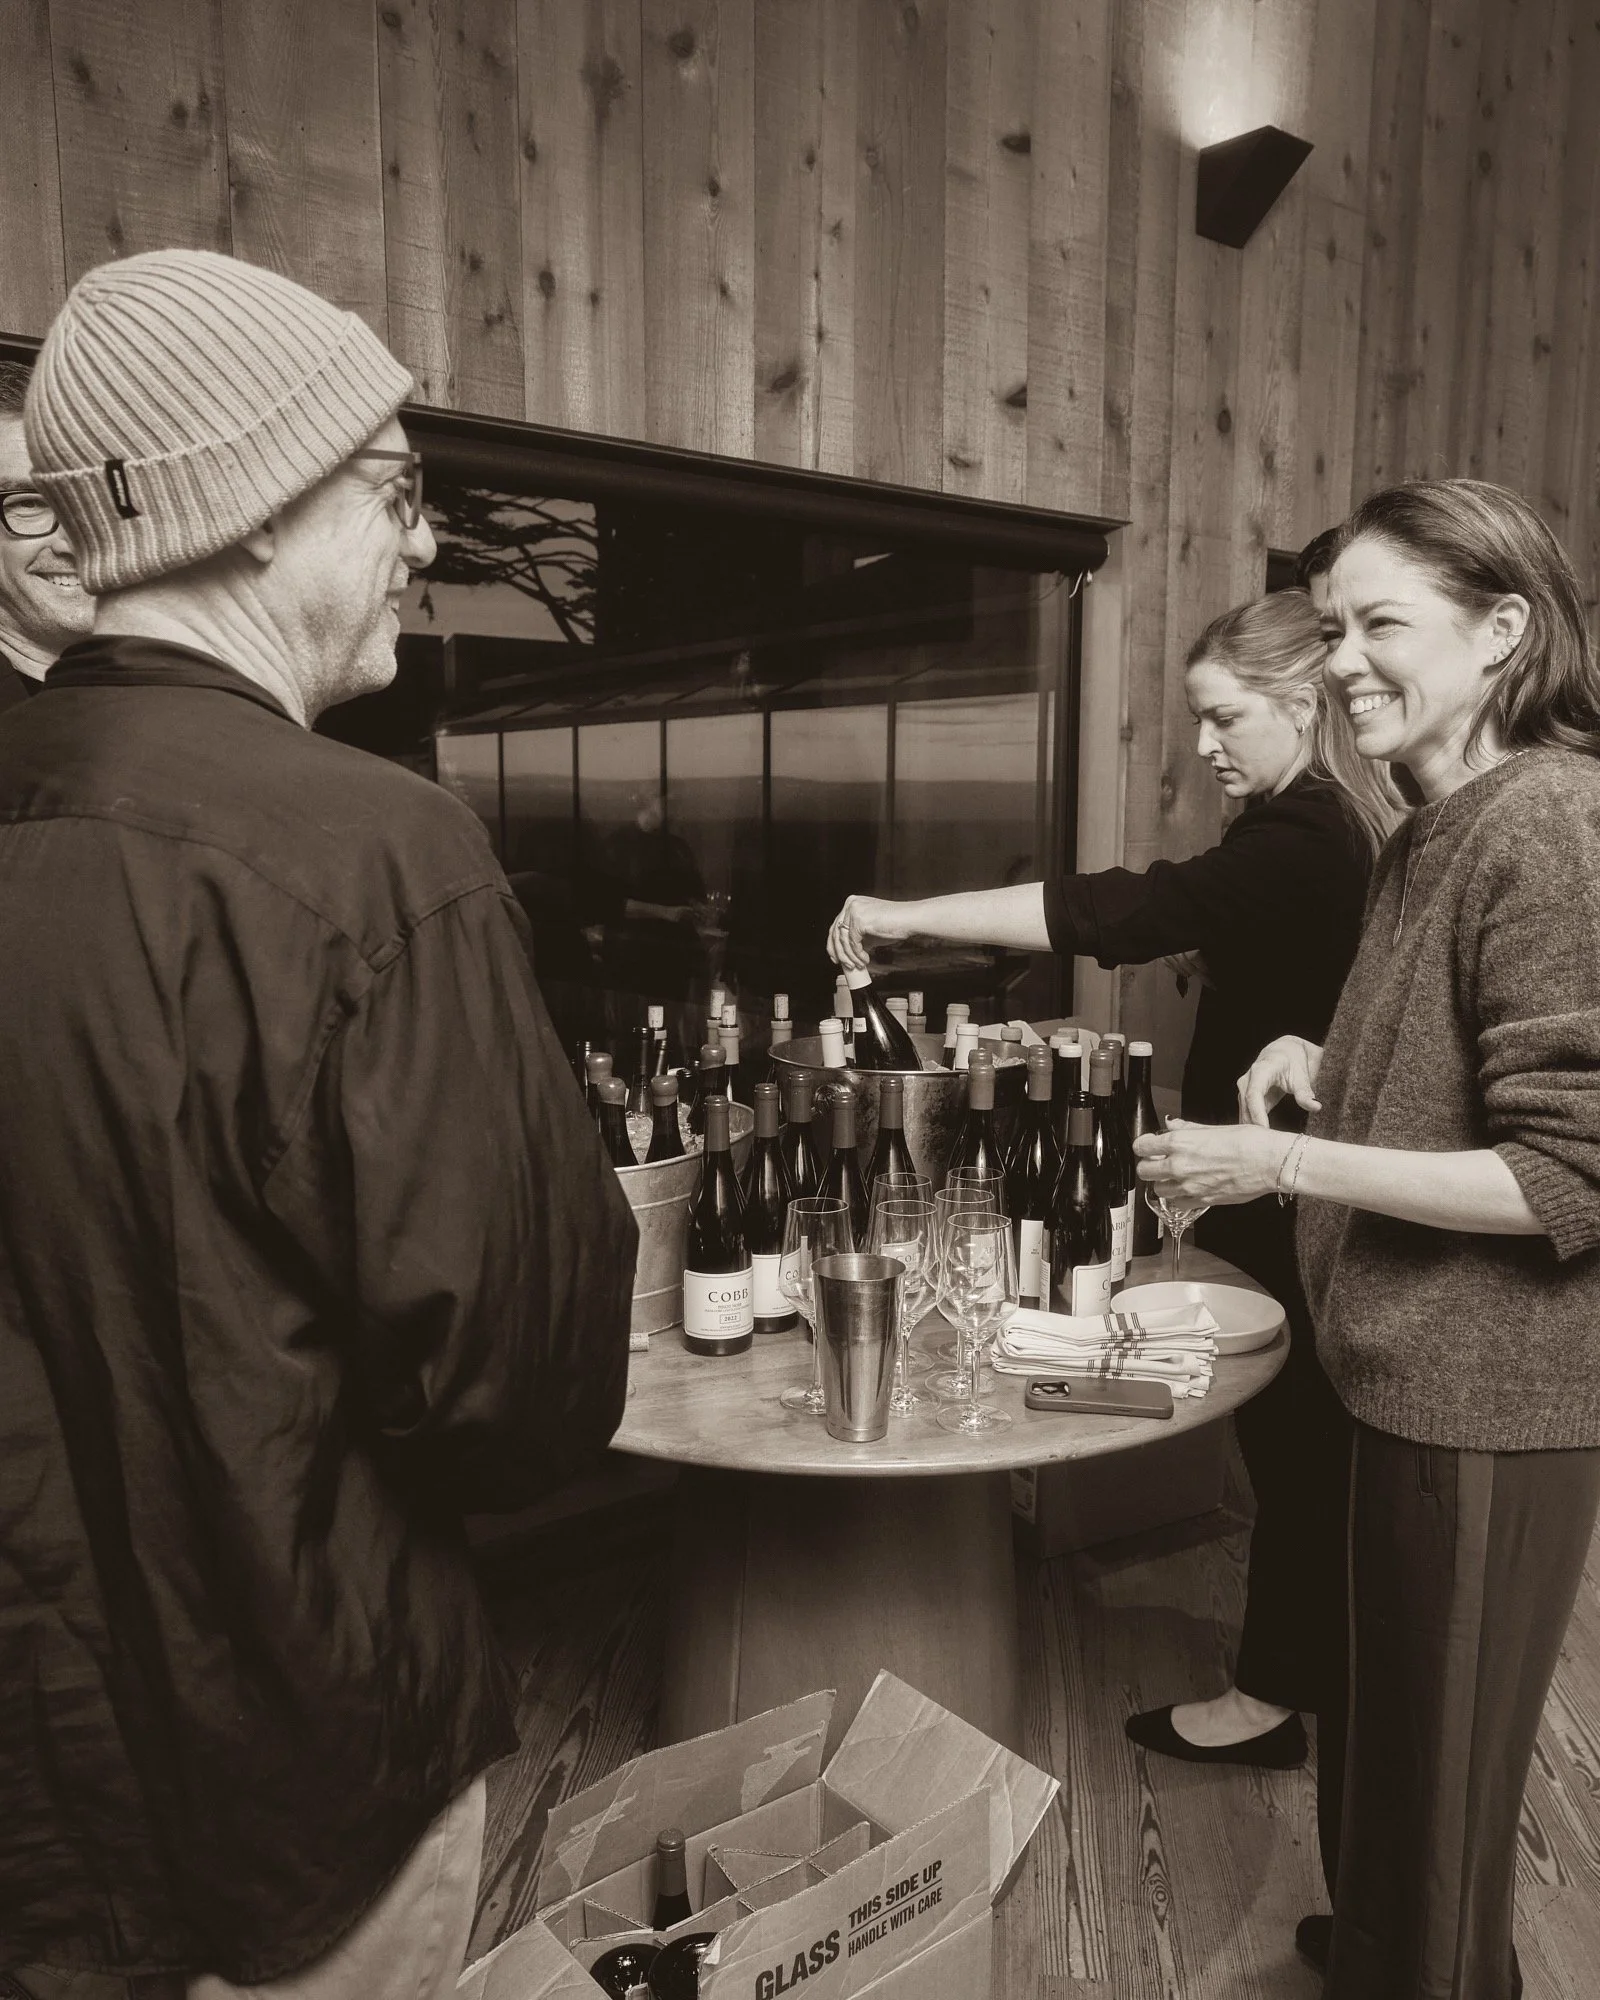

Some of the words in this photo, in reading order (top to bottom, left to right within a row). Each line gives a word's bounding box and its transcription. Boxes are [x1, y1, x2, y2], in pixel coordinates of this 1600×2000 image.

[708, 1288, 749, 1303] COBB
[848, 1895, 882, 1929] THIS
[885, 1873, 919, 1906] SIDE
[922, 1860, 943, 1884] UP
[848, 1920, 888, 1958] HANDLE
[889, 1903, 915, 1932] WITH
[918, 1887, 943, 1916] CARE
[755, 1930, 840, 2000] GLASS
